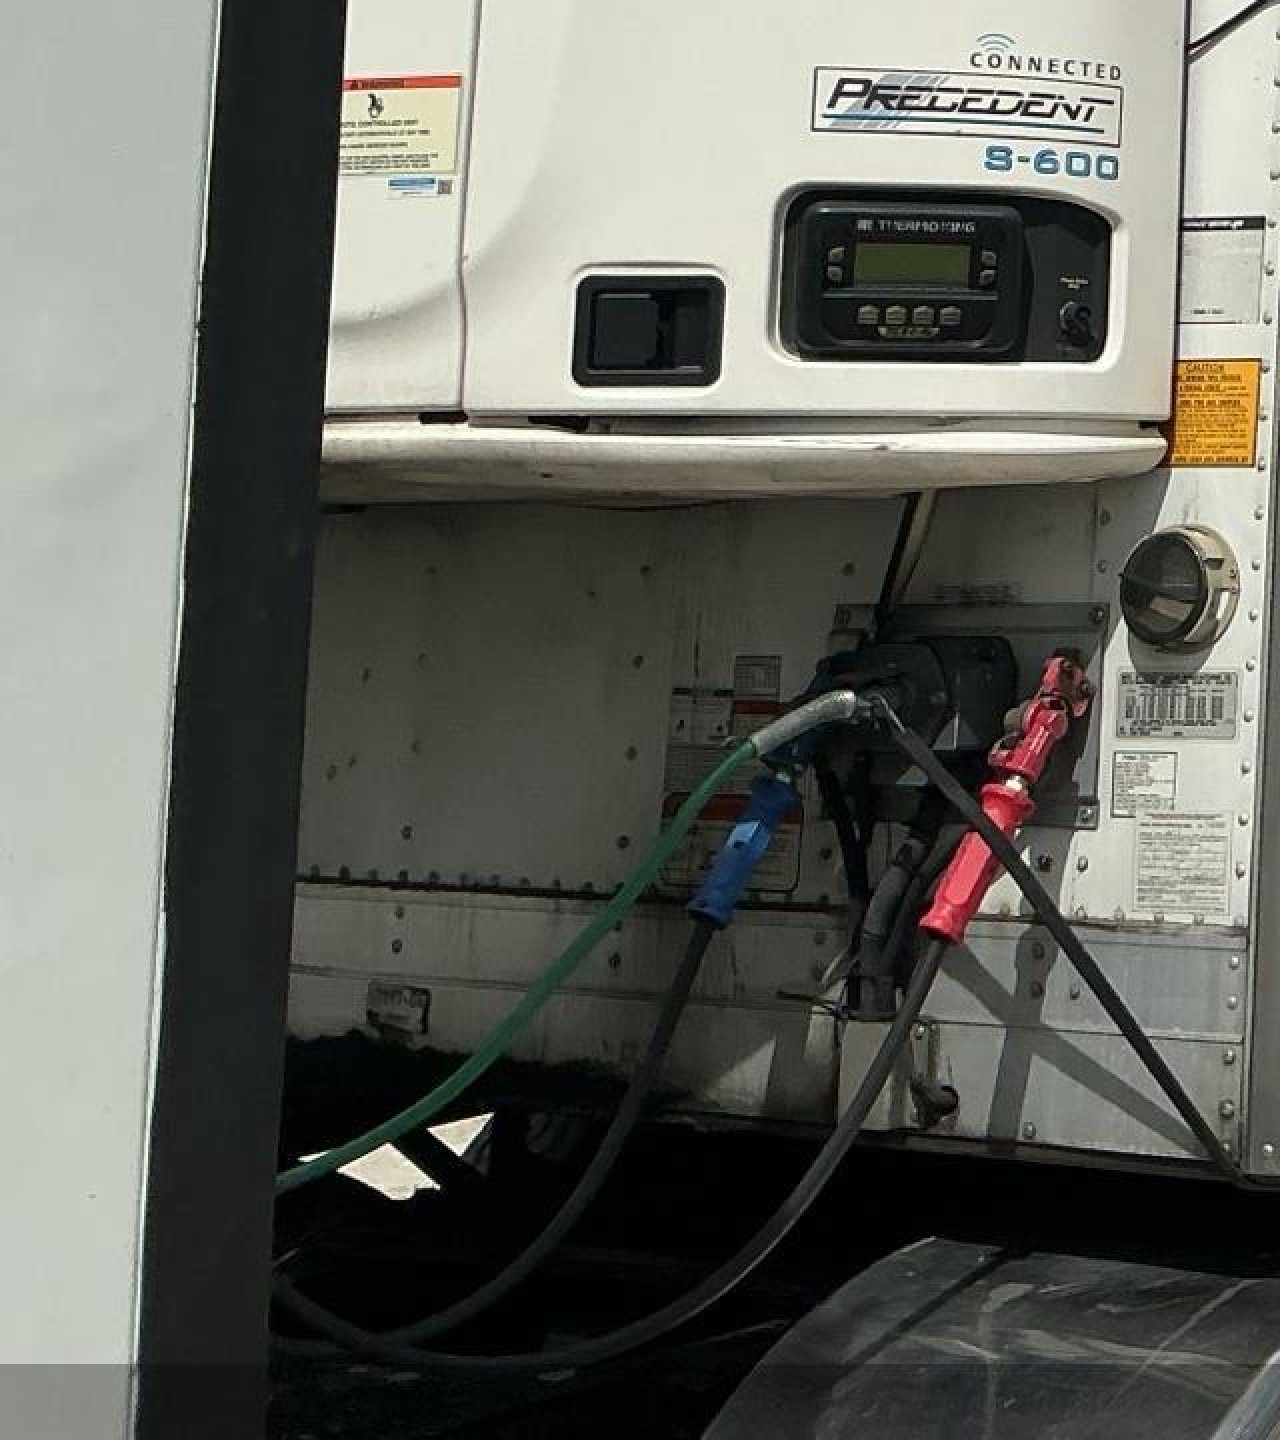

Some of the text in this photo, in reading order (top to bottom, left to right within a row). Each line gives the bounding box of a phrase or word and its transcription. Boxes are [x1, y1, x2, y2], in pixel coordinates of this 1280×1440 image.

[969, 51, 1121, 81] CONNECTED
[825, 76, 1115, 123] PRECEDENT
[983, 145, 1119, 181] S-600
